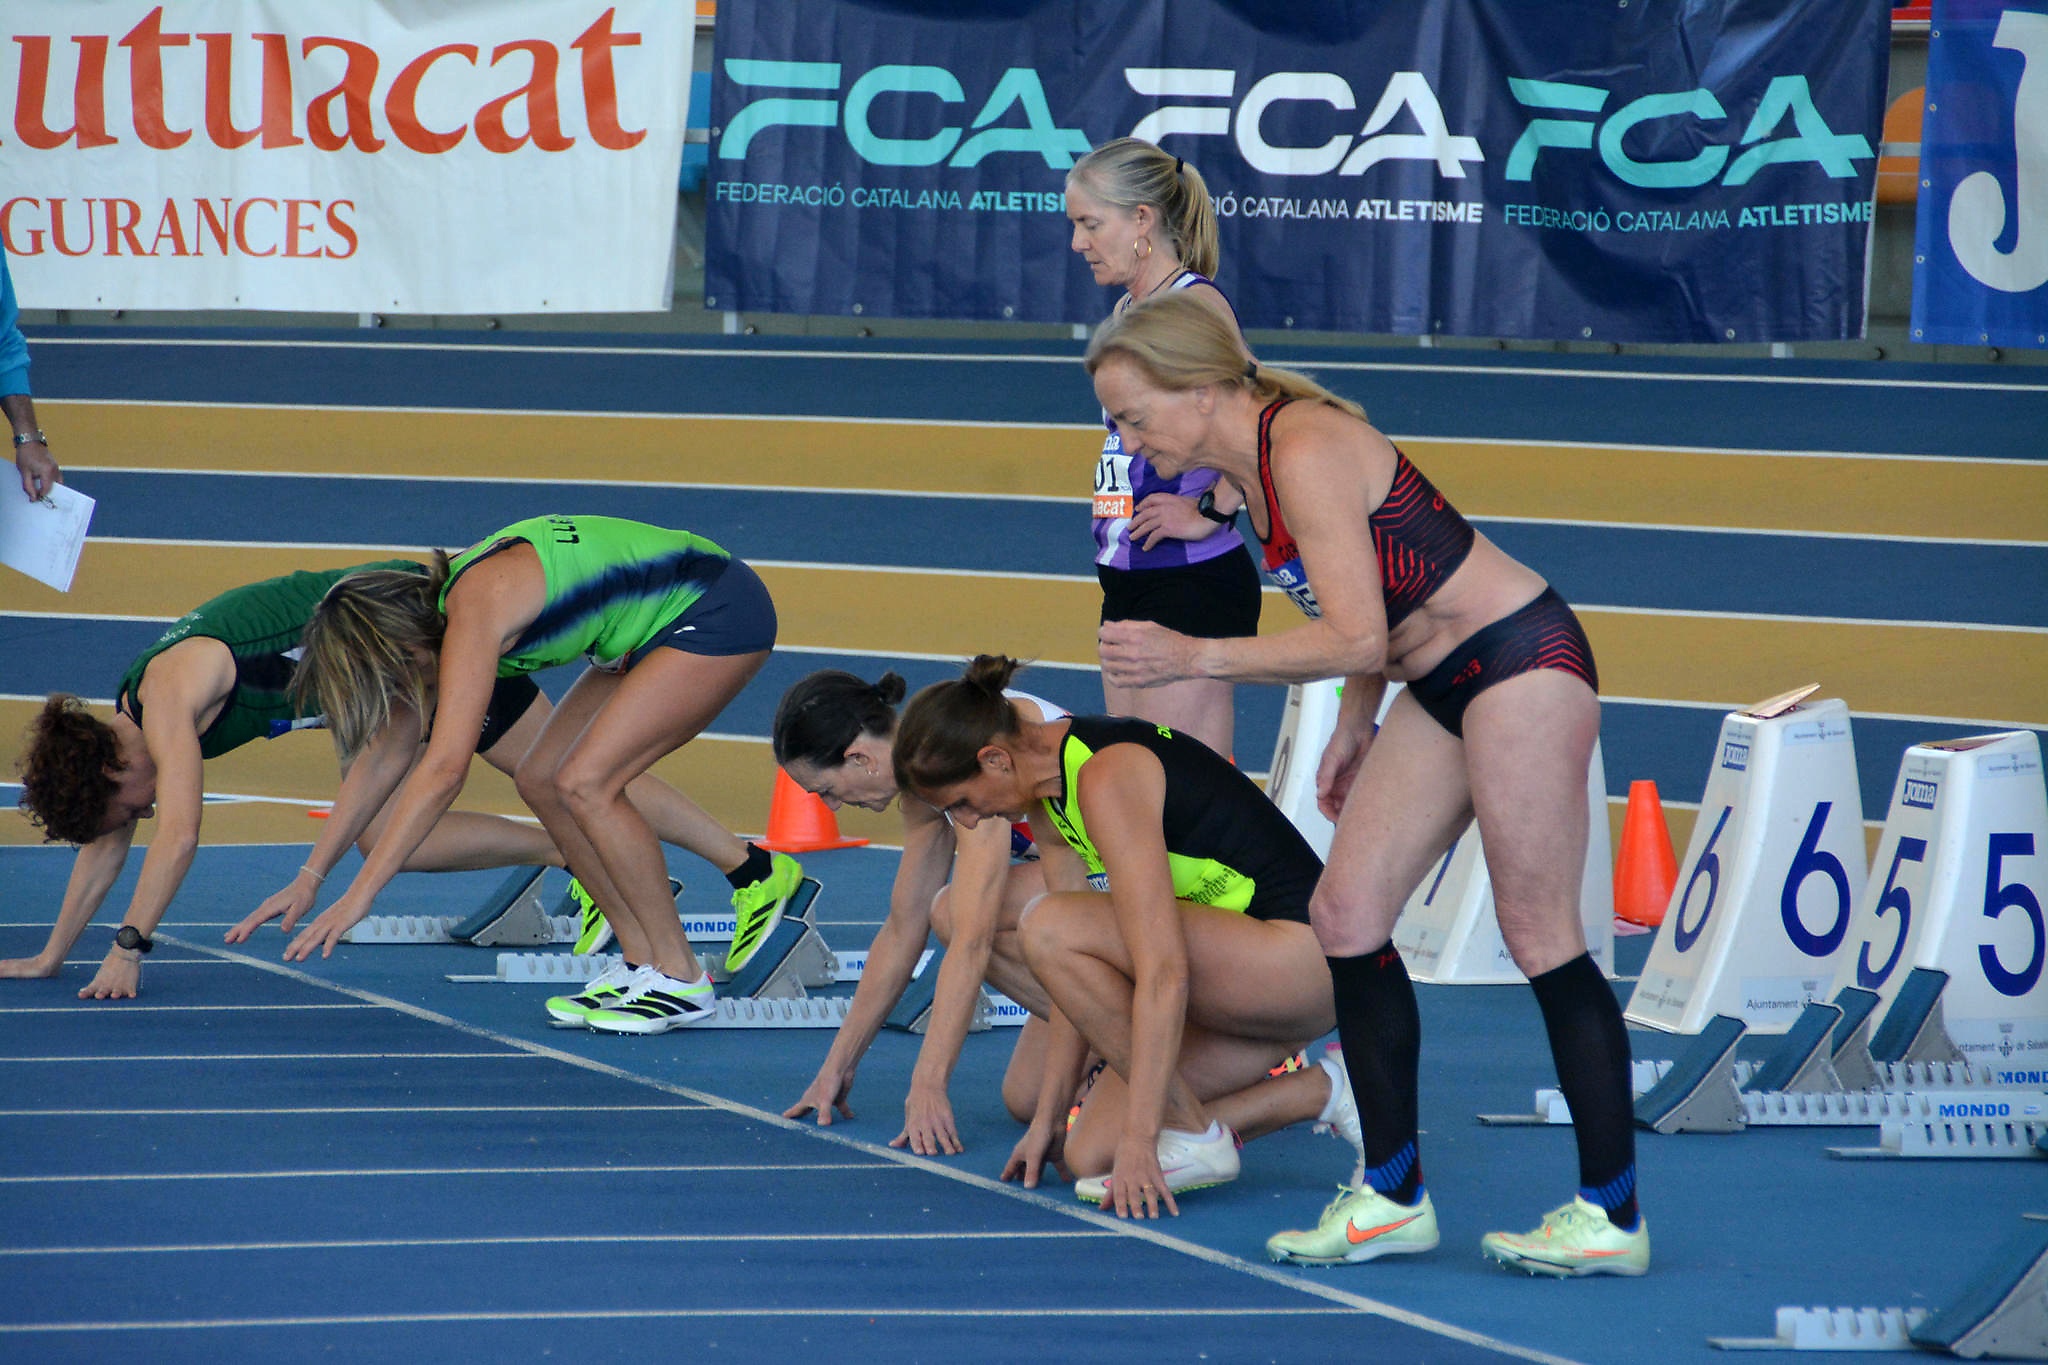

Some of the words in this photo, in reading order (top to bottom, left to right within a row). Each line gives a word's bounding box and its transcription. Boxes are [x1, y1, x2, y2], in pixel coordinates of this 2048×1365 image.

[0, 6, 647, 154] utuacat
[718, 58, 1094, 170] FCA
[1123, 67, 1486, 178] FCA
[1504, 74, 1876, 189] FCA
[715, 181, 846, 208] FEDERACIÓ
[851, 187, 963, 210] CATALANA
[968, 190, 1067, 213] ATLETIS
[1242, 196, 1350, 220] CATALANA
[1354, 199, 1484, 224] ATLETISME
[1504, 204, 1611, 232] FEDERACIÓ
[1616, 210, 1731, 232] CATALANA
[1737, 201, 1873, 227] ATLETISME
[1674, 805, 1734, 953] 6
[1780, 801, 1851, 957] 6
[1857, 836, 1928, 990] 5
[1978, 832, 2046, 997] 5
[1939, 1104, 2010, 1118] MONDO
